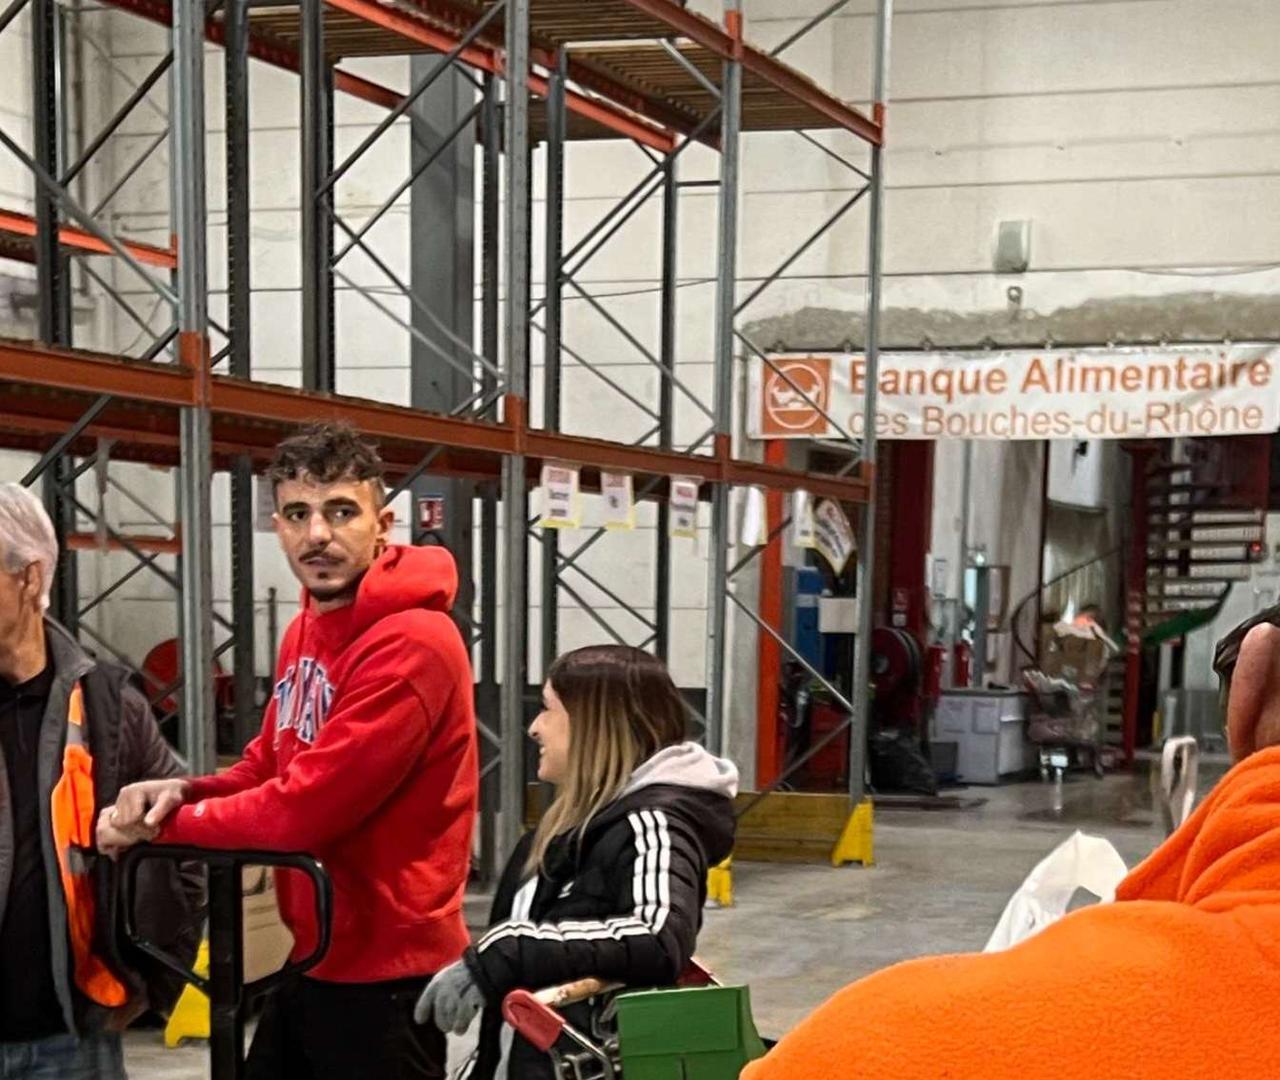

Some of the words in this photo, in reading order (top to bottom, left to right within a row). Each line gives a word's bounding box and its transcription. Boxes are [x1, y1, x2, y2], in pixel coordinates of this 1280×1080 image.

[849, 359, 1007, 403] Banque
[1020, 353, 1271, 394] Alimentaire
[922, 400, 1262, 437] Bouches-du-Rhône
